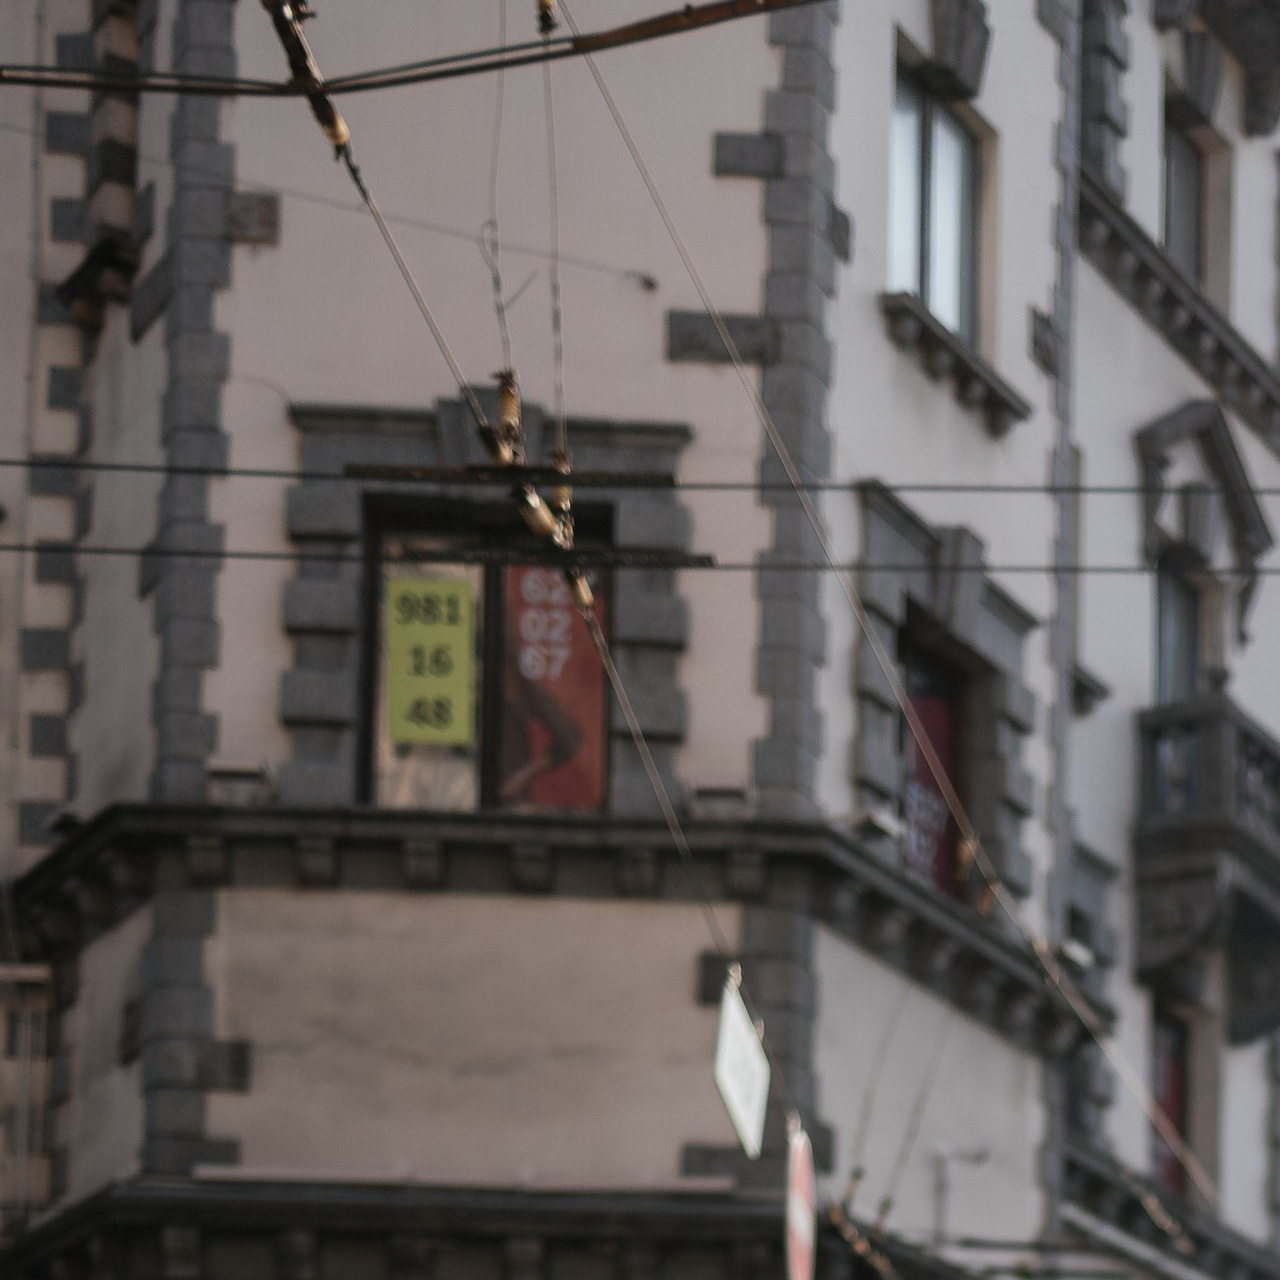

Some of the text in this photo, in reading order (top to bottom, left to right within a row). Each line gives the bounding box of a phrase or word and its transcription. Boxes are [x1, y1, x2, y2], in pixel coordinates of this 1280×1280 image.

[394, 593, 463, 625] 981
[519, 608, 572, 642] 02
[407, 645, 454, 678] 16
[518, 646, 571, 681] 67
[405, 696, 454, 730] 48
